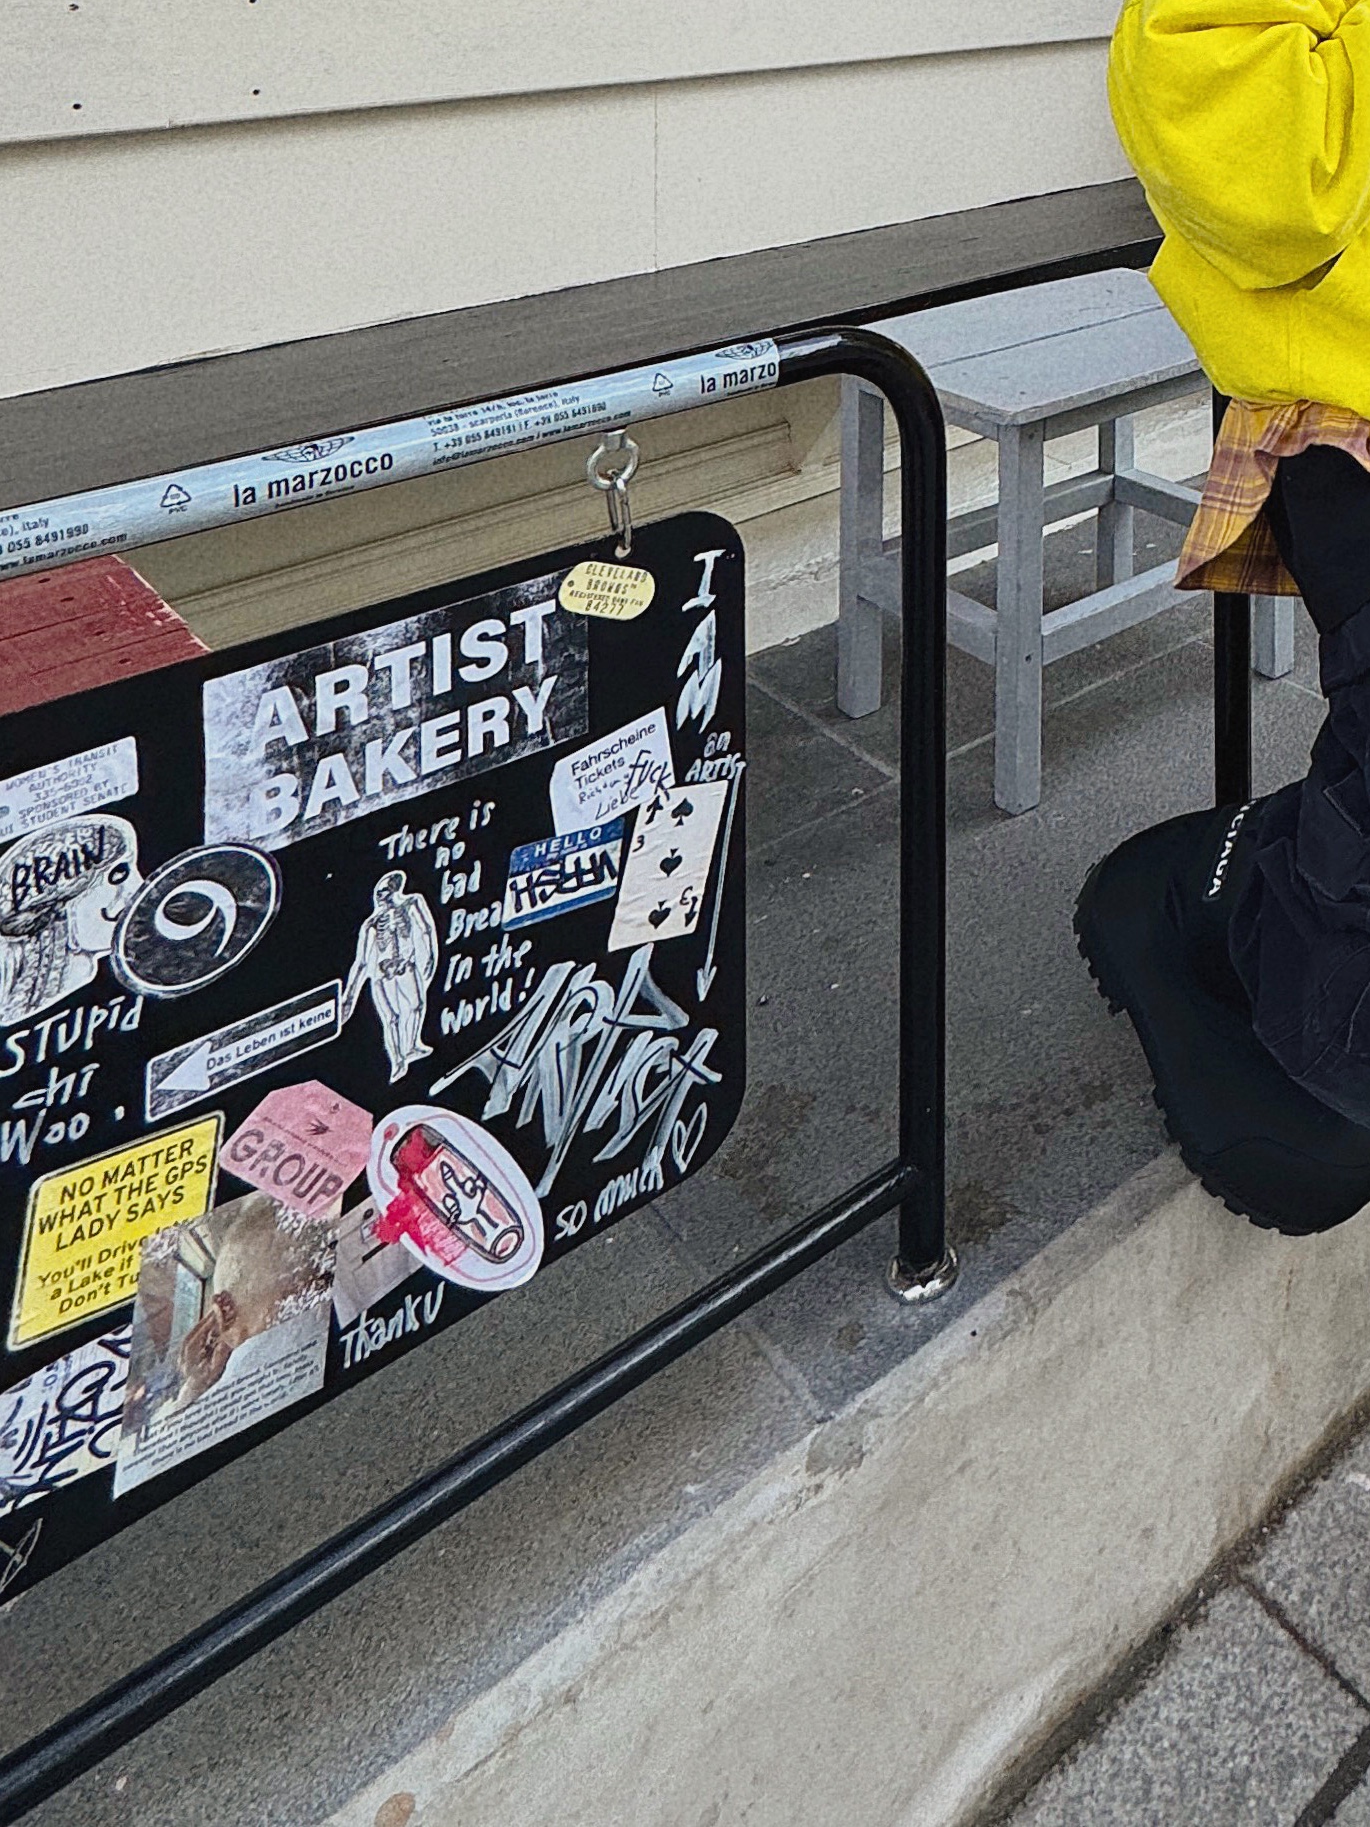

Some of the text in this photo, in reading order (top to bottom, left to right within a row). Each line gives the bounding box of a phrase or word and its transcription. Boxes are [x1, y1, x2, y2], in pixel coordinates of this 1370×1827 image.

[700, 374, 716, 394] la
[723, 361, 776, 388] marzo
[234, 453, 393, 507] la marzocco
[585, 563, 648, 583] CLEVELAND
[682, 549, 726, 612] I
[250, 599, 556, 759] ARTIST
[247, 674, 558, 840] BAKERY
[571, 723, 657, 776] Fahrscheine
[574, 756, 625, 789] Tickets
[685, 752, 746, 795] ARTIST
[21, 800, 76, 830] STUDENT
[378, 799, 496, 860] There is
[434, 841, 465, 869] no
[534, 827, 602, 857] HELLO
[1207, 800, 1257, 896] CIAGA
[10, 825, 104, 910] BRAIN
[441, 860, 482, 904] bad
[445, 900, 503, 945] Brea
[481, 933, 532, 978] the
[206, 1008, 332, 1071] Das Leben ist keine
[60, 1138, 195, 1205] NO MATTER
[230, 1128, 344, 1206] GROUP
[38, 1154, 207, 1236] WHAT THE GPS
[55, 1186, 185, 1252] LADY SAYS
[38, 1255, 92, 1288] You'll
[51, 1254, 134, 1300] a Lake if
[59, 1280, 111, 1315] Don't
